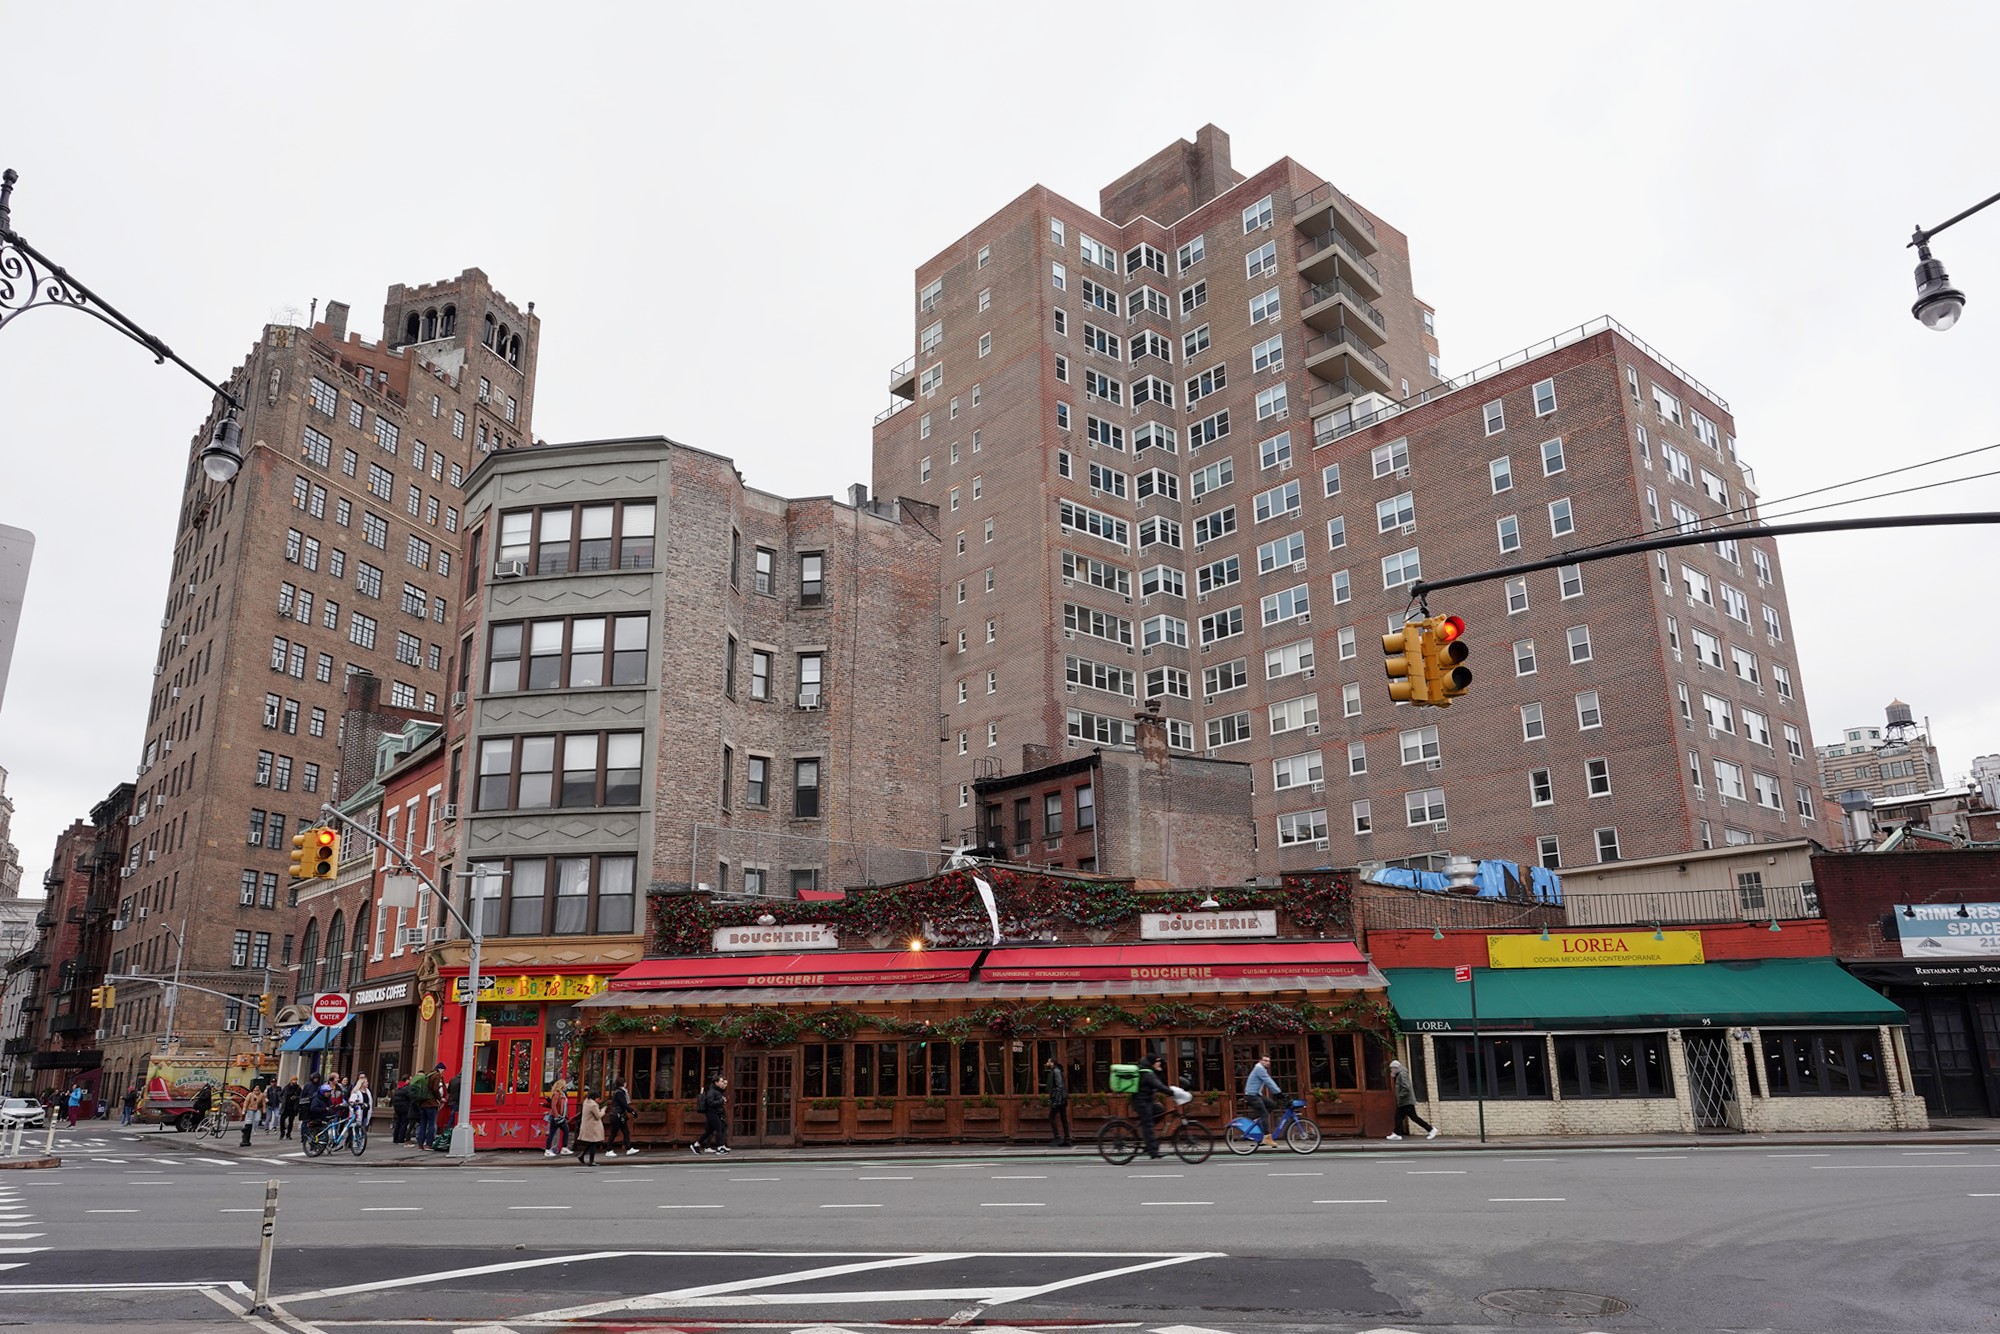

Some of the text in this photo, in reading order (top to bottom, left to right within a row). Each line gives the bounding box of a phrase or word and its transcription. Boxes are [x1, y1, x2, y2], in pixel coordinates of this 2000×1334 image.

[1966, 906, 2000, 919] RES
[1158, 918, 1258, 932] BOUCHERIE
[1947, 921, 2000, 935] SPACE
[729, 931, 820, 944] BOUCHERIE
[1562, 938, 1629, 953] LOREA
[1598, 953, 1662, 962] CONTEMPORANEA
[838, 974, 875, 982] BREAKFAST
[1130, 967, 1212, 979] BOUCHERIE
[747, 974, 825, 986] BOUCHERIE
[355, 983, 407, 1005] STARBUCKS COFFEE
[1416, 1020, 1452, 1030] LOREA
[1702, 1018, 1711, 1026] 95
[1742, 1031, 1750, 1040] A
